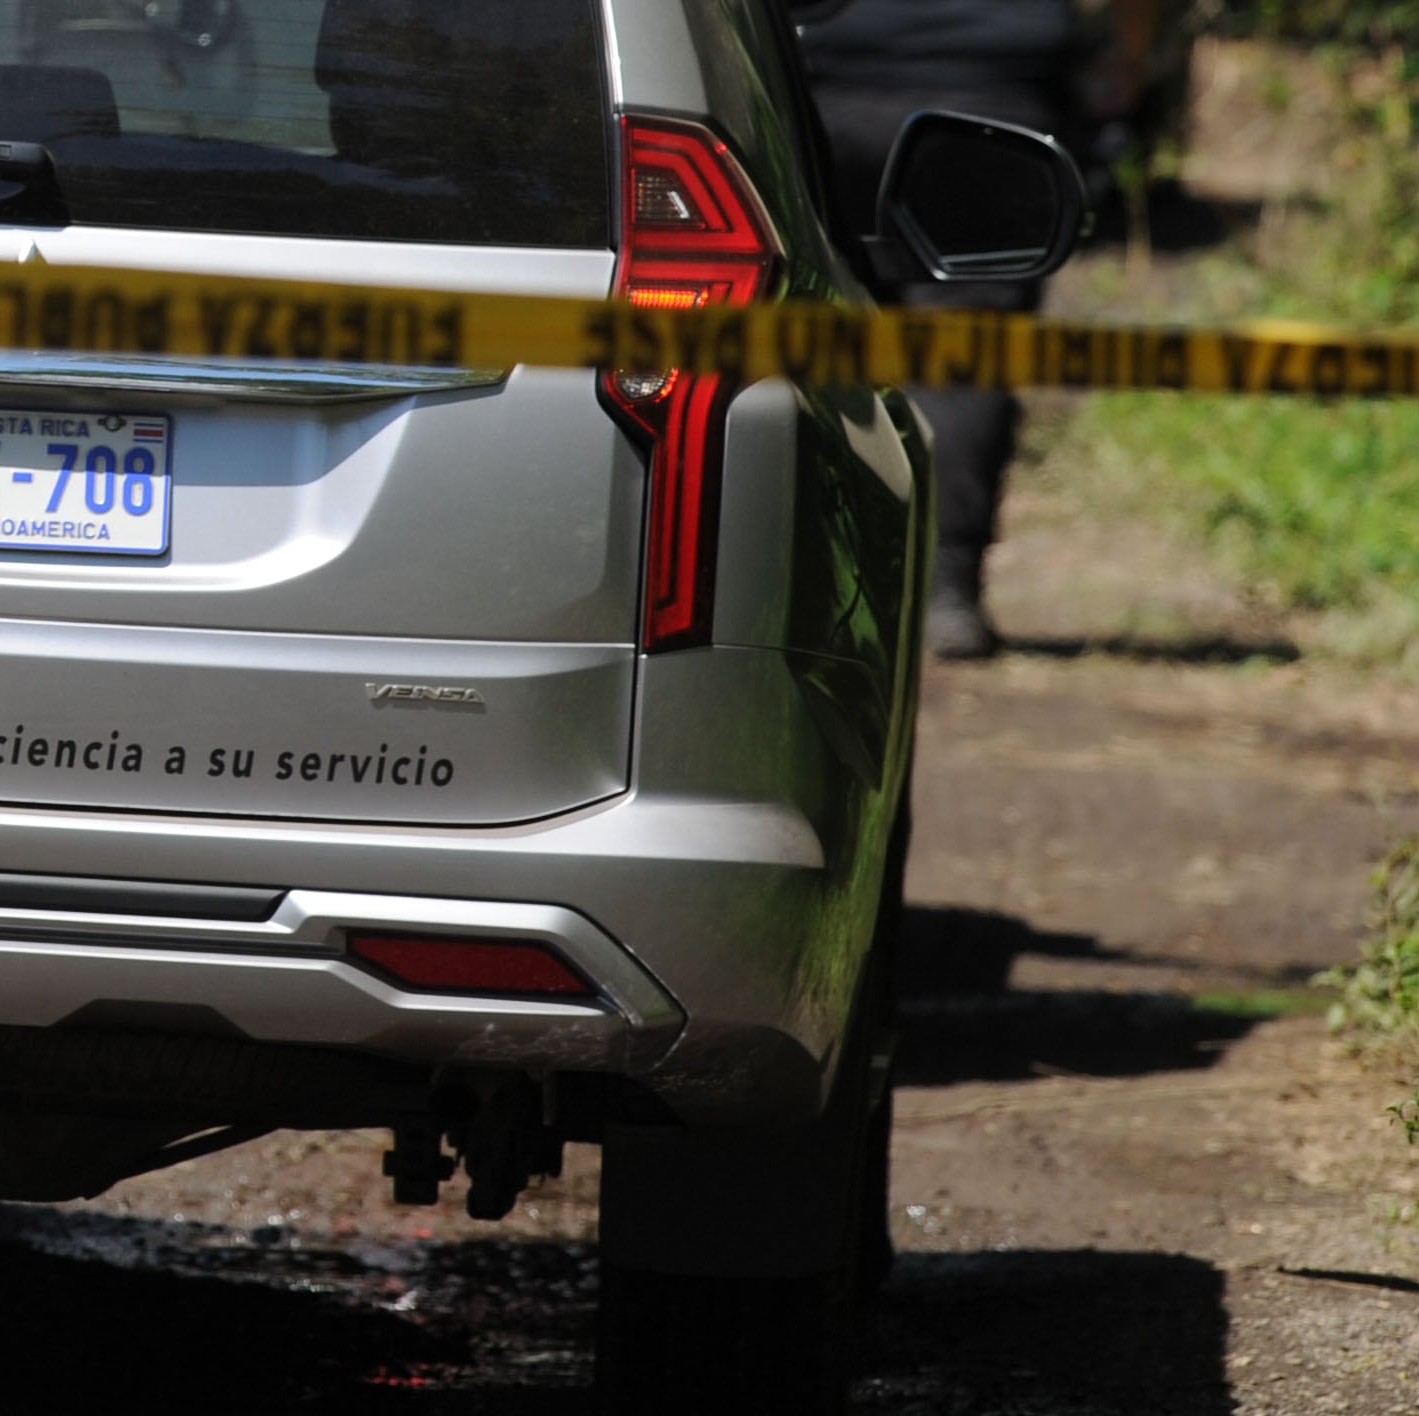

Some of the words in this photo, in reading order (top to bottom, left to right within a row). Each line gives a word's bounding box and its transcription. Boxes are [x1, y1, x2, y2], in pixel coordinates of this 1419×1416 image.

[41, 417, 91, 439] RICA
[164, 745, 187, 775] a
[207, 744, 255, 778] su
[275, 743, 455, 787] servicio
